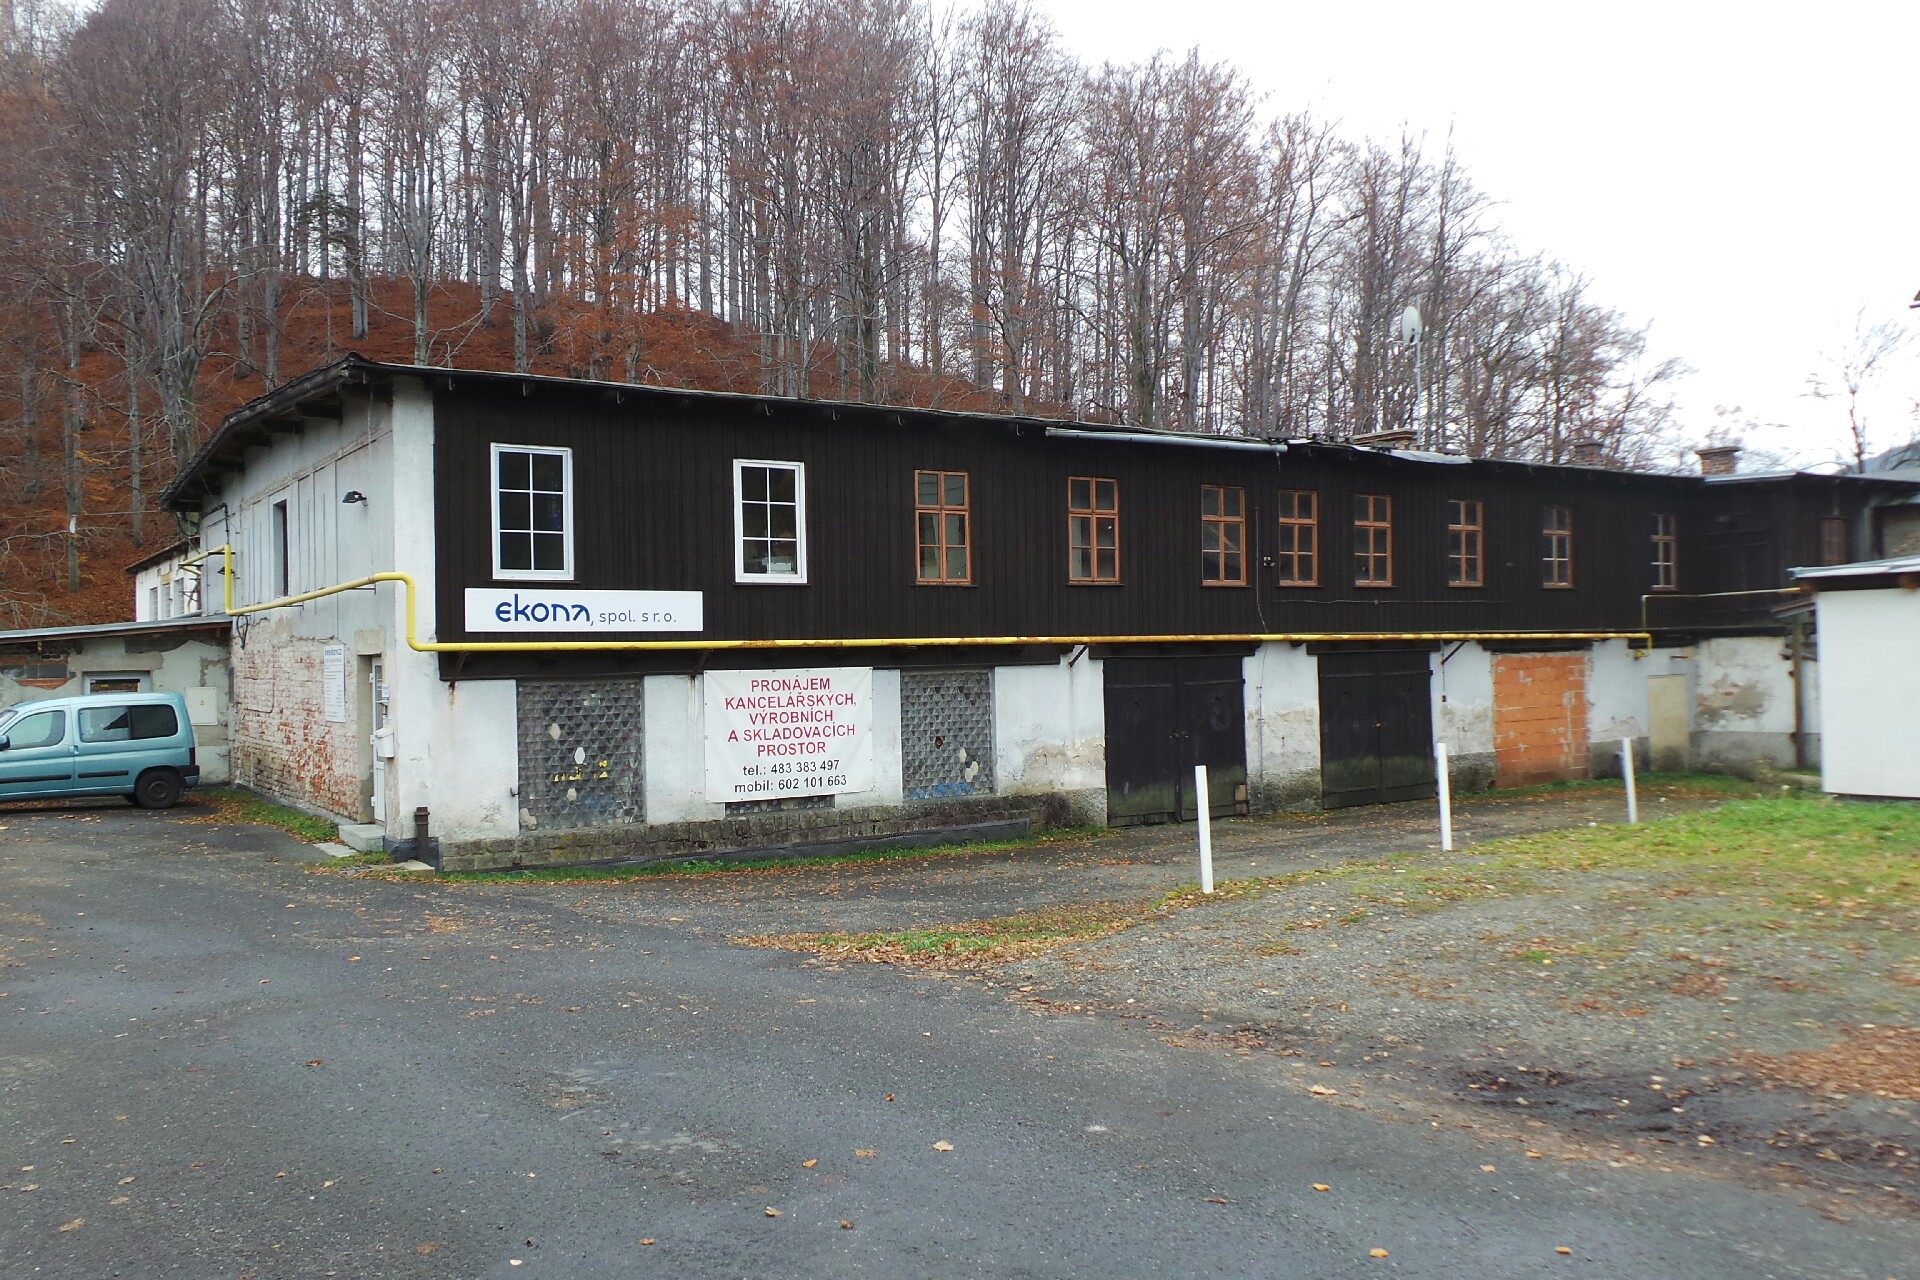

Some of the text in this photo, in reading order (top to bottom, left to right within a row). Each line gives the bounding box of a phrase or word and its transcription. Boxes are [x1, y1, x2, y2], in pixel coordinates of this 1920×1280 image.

[495, 593, 594, 626] ekona,
[599, 609, 636, 625] spol.
[641, 611, 649, 622] s
[751, 675, 830, 693] PRONÁJEM
[725, 691, 856, 711] KANCELÁŘSKÝCH,
[749, 708, 833, 725] VÝROBNÍCH
[728, 722, 855, 742] A SKLADOVACÍCH
[757, 742, 826, 757] PROSTOR
[743, 760, 840, 776] tel.: 483 383 497
[734, 775, 847, 793] mobil: 602 101 663
